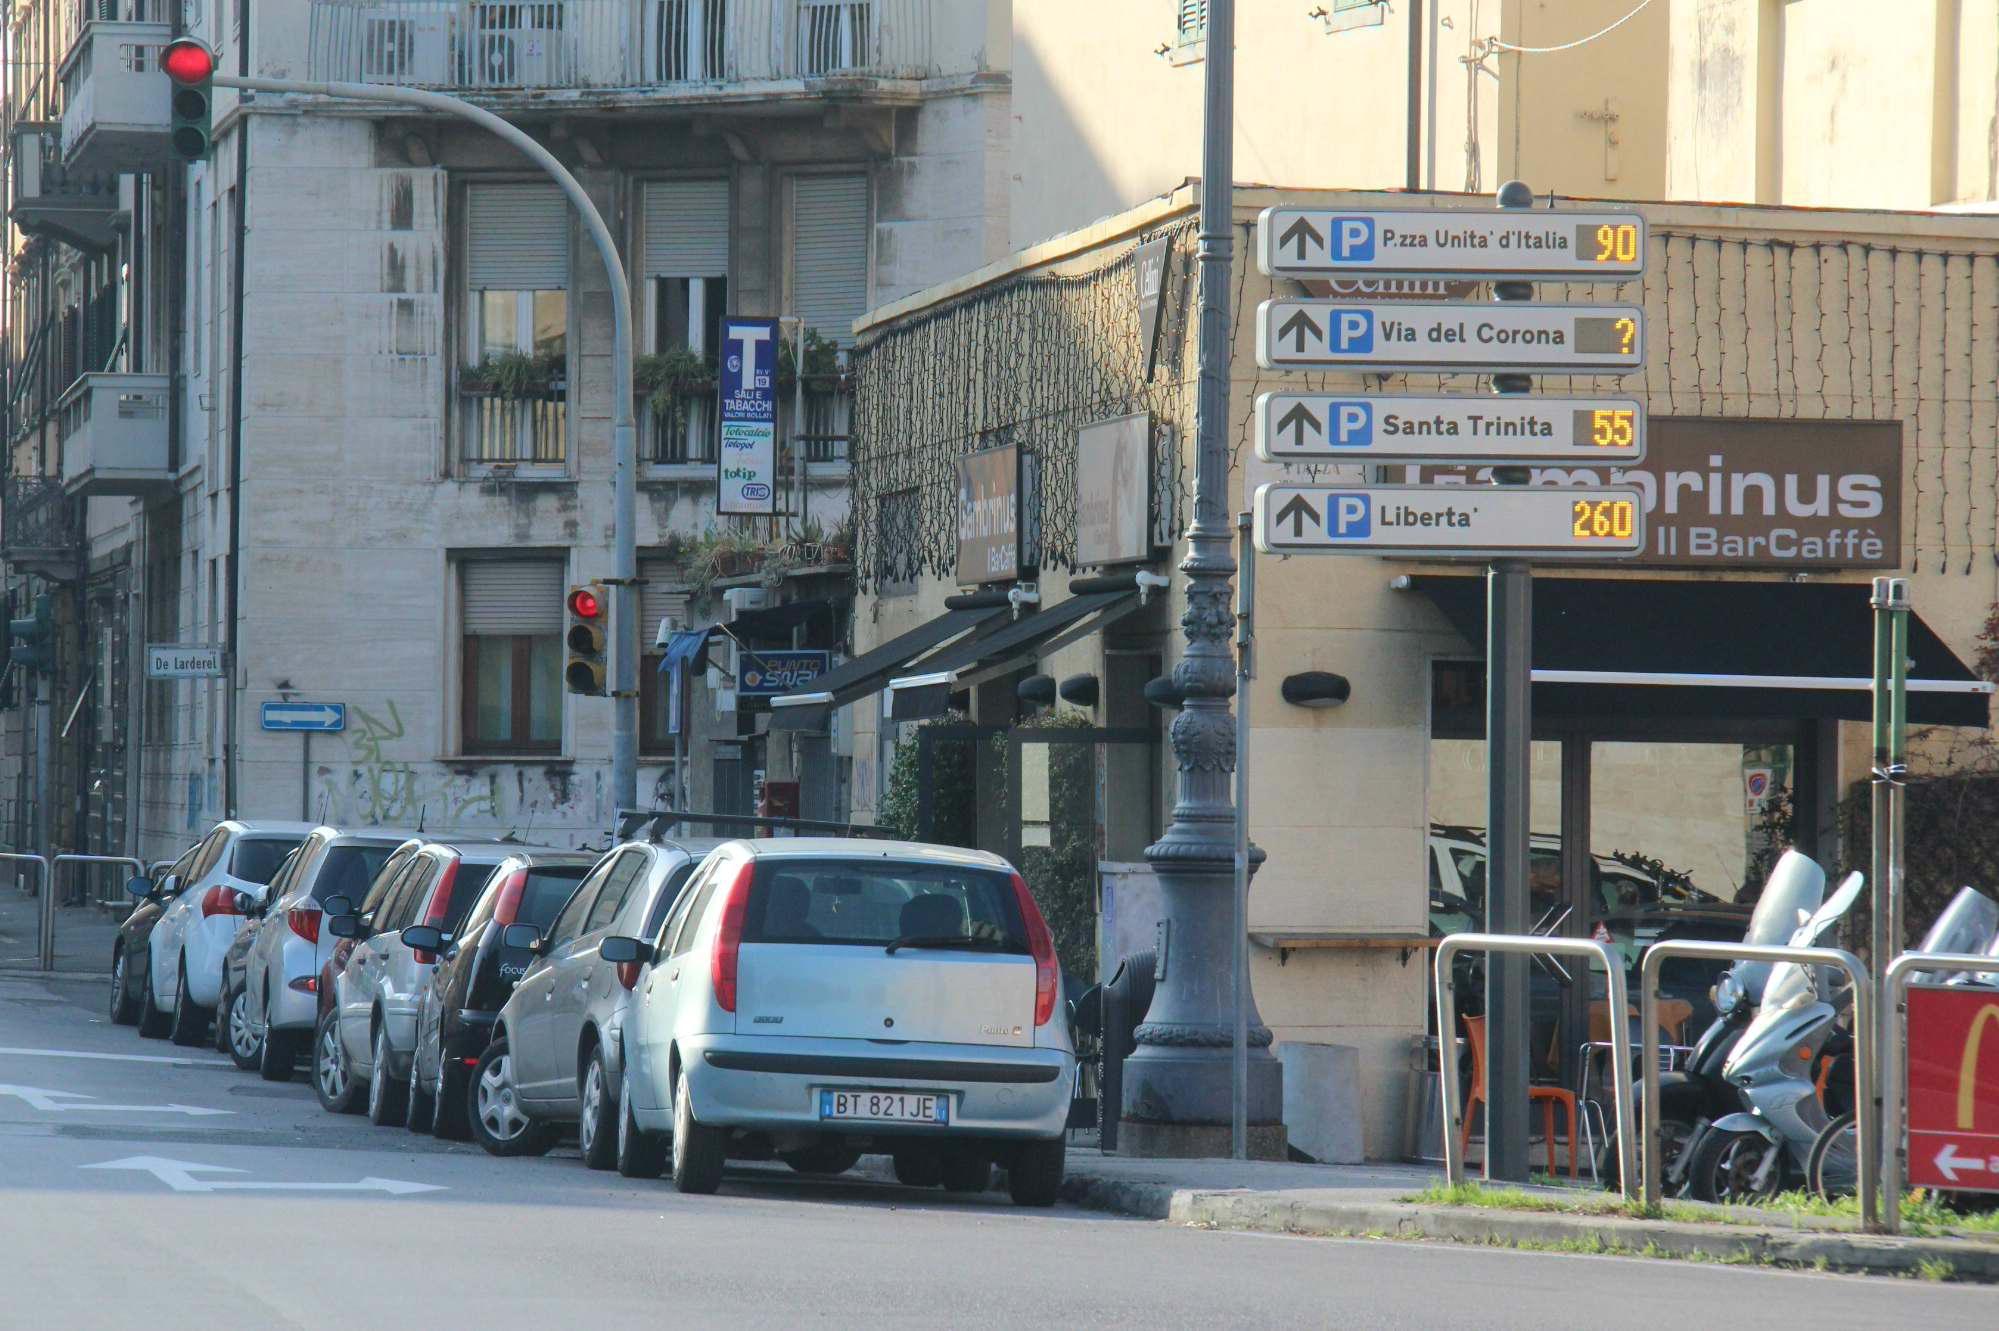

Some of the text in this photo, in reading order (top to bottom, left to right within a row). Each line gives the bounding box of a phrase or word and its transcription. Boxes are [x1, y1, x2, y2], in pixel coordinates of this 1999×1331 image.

[1342, 221, 1568, 256] P P.zza Unita' d'Italia
[1597, 224, 1636, 261] 90
[1340, 314, 1565, 350] P Via del Corona
[728, 325, 770, 390] T
[725, 399, 772, 411] TABACCHI
[734, 390, 762, 399] SALI E
[1340, 406, 1553, 442] P Santa Trinita
[1593, 410, 1633, 446] 55
[724, 467, 756, 481] totip
[1338, 498, 1478, 533] P Liberta'
[1574, 501, 1633, 537] 260
[1657, 526, 1883, 559] Il BarCaffè
[156, 656, 217, 670] De Larderel
[837, 1094, 861, 1115] BT
